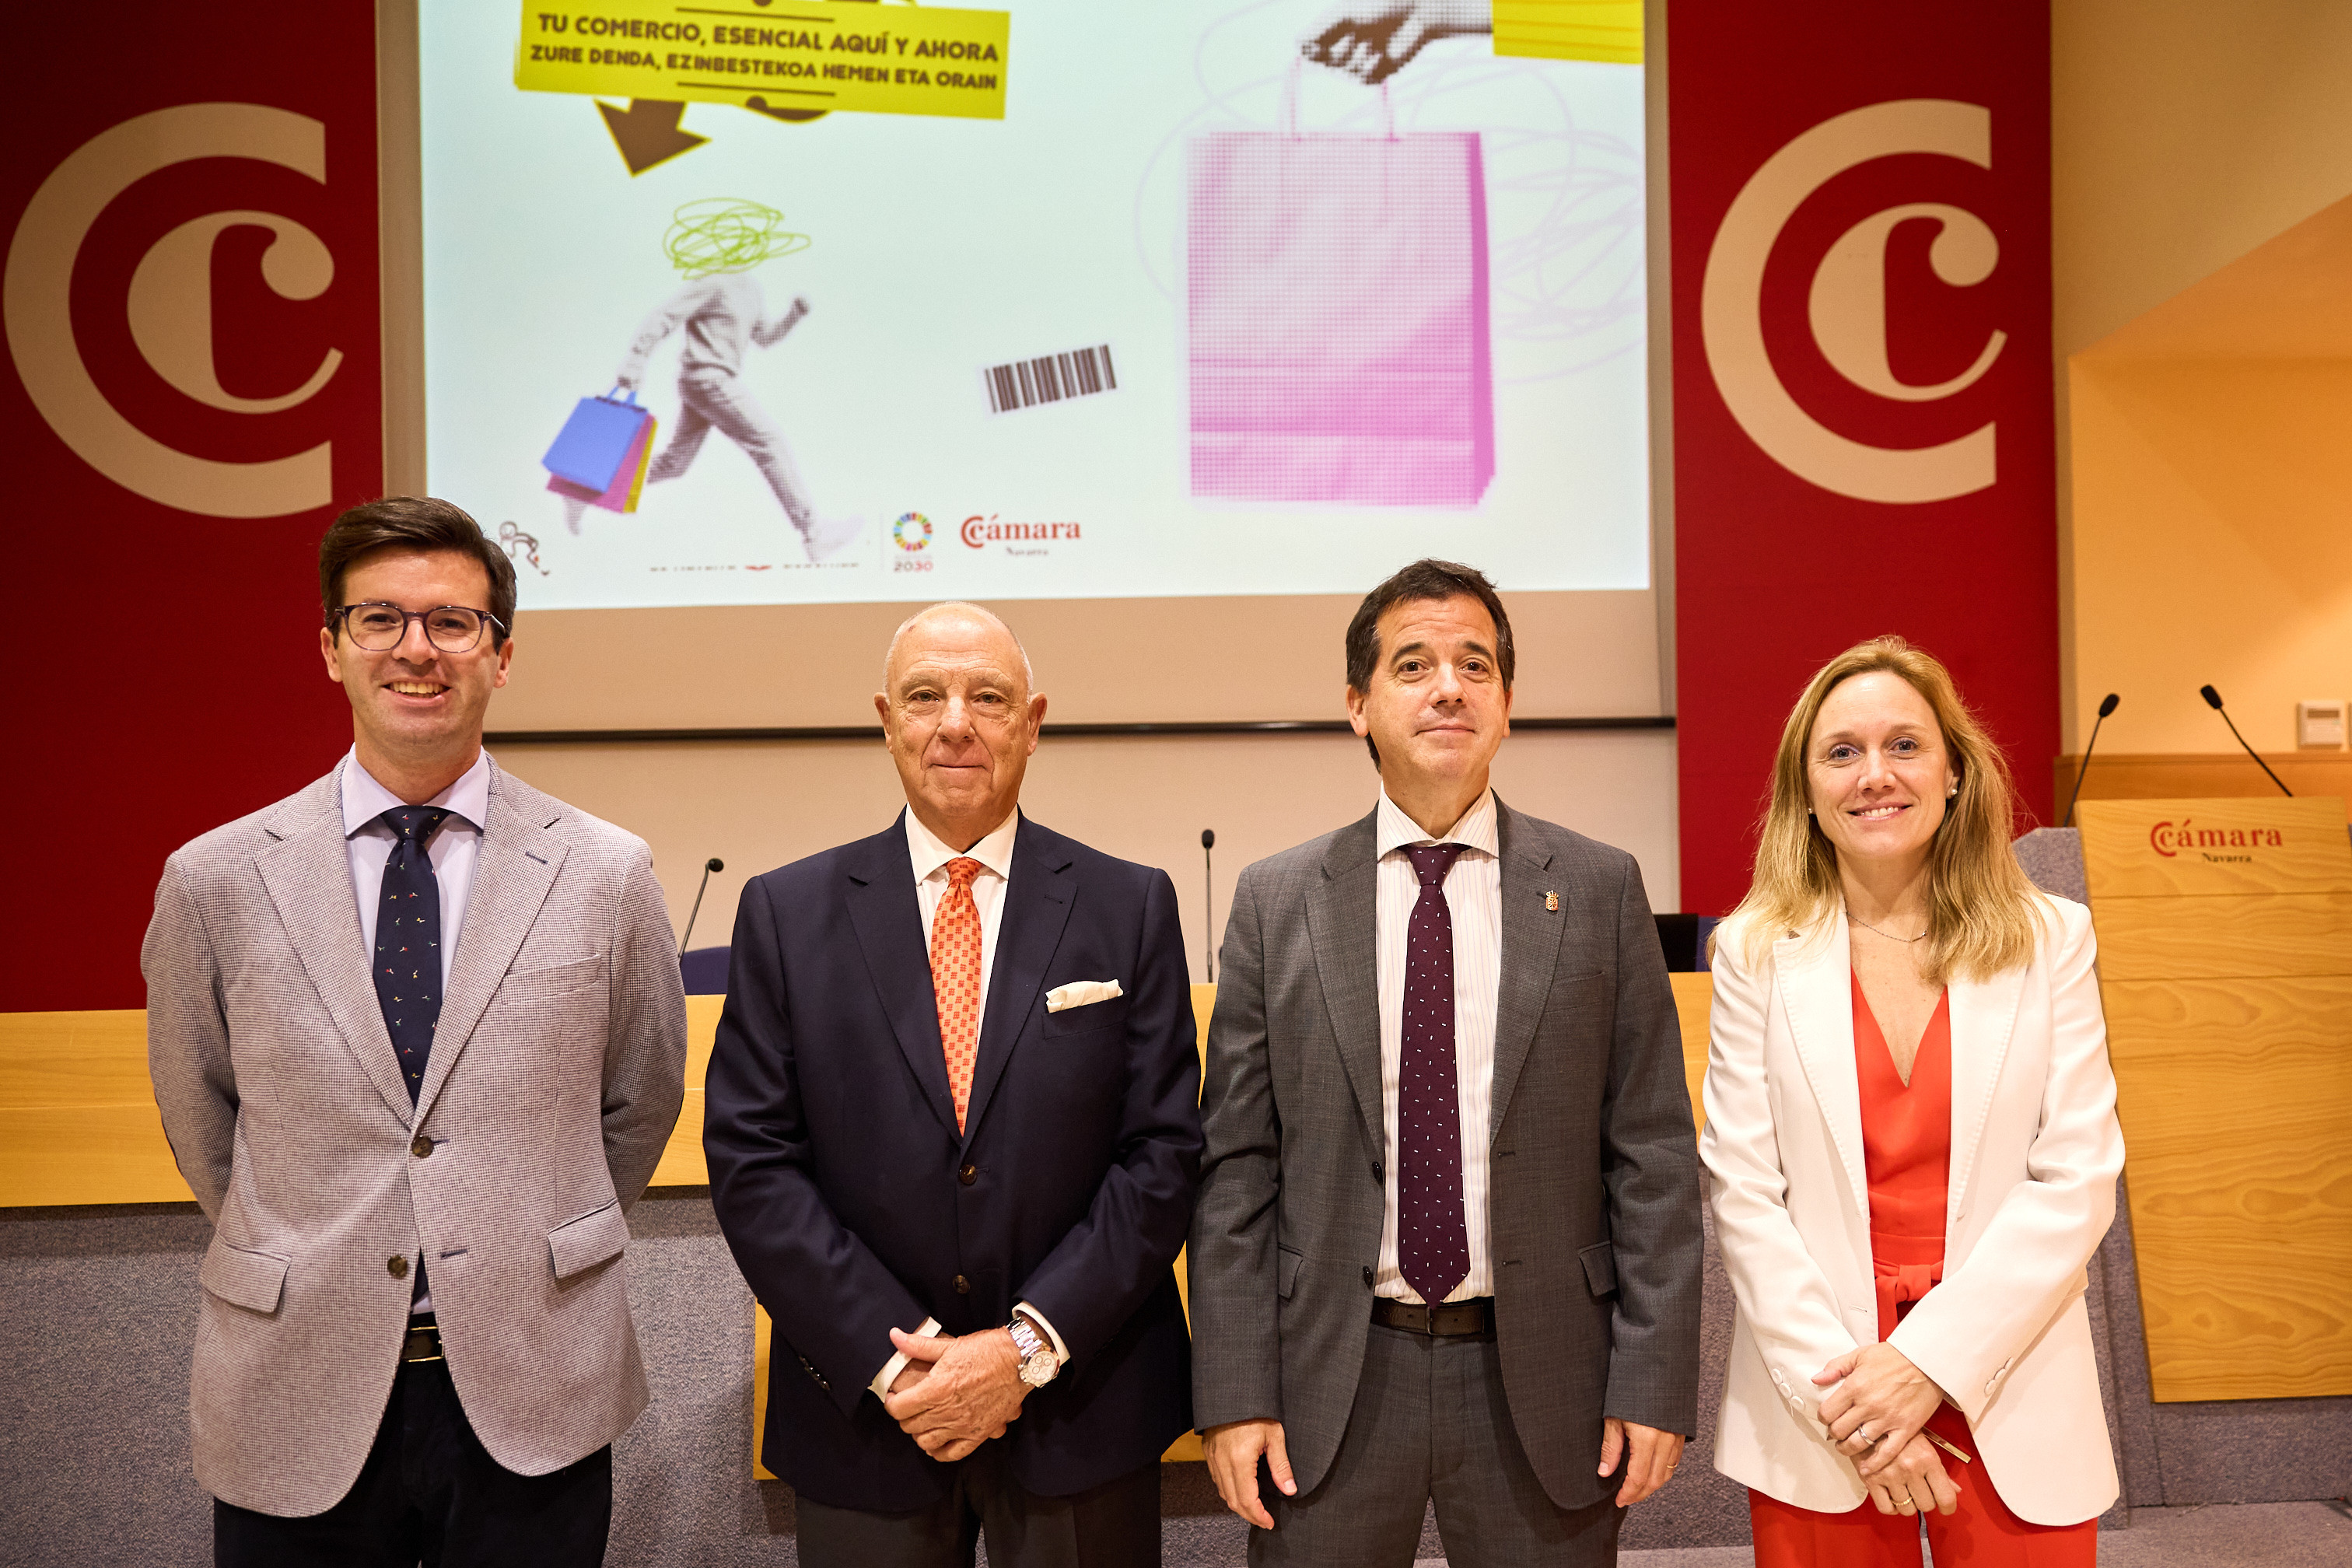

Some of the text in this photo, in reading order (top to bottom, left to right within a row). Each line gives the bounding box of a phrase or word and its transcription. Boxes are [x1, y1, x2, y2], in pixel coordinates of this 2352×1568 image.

[538, 13, 999, 61] TU COMERCIO, ESENCIAL AQUÍ Y AHORA
[530, 44, 997, 89] ZURE DENDA, EZINBESTEKOA HEMEN ETA ORAIN
[894, 560, 933, 572] 2030
